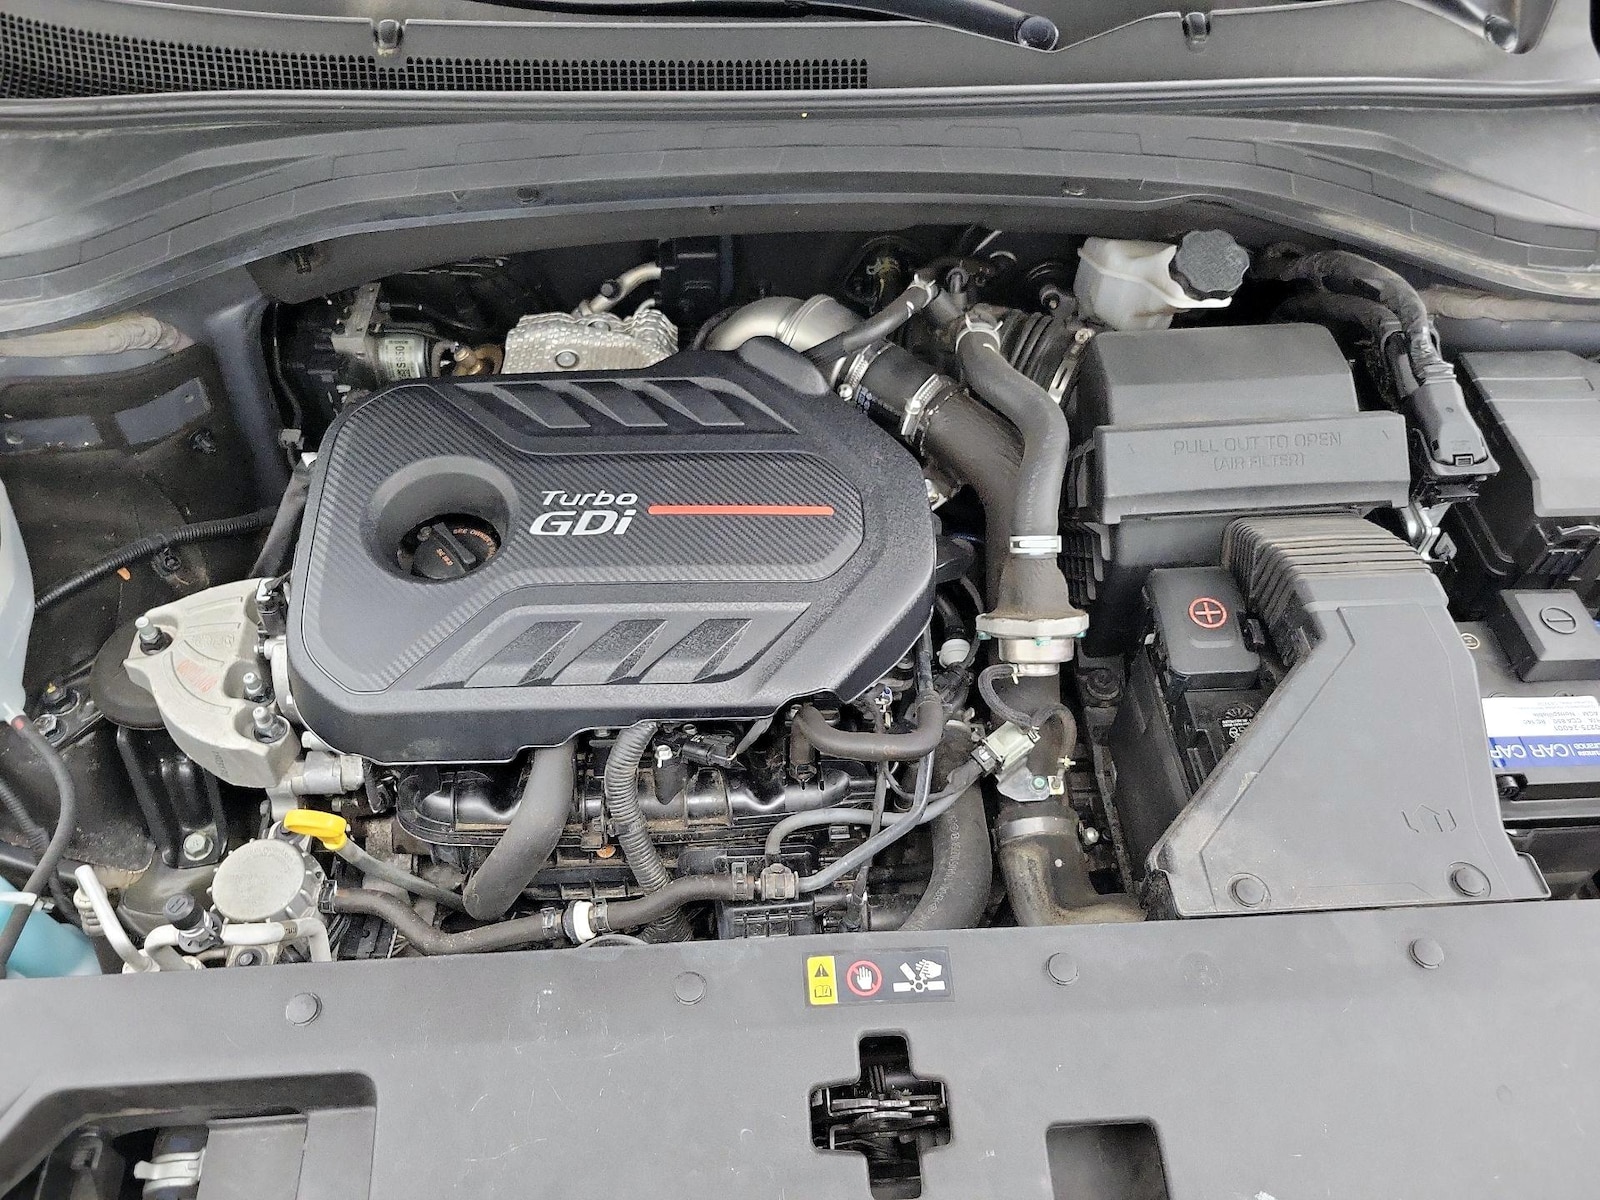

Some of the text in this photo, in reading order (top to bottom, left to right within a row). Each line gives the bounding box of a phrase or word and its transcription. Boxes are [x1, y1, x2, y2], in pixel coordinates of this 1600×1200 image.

[1173, 431, 1342, 455] PULL OUT TO OPEN
[1213, 452, 1305, 472] (AIR FILTER)
[541, 489, 638, 506] Turbo
[529, 509, 637, 536] GDi
[1528, 743, 1570, 758] CAR
